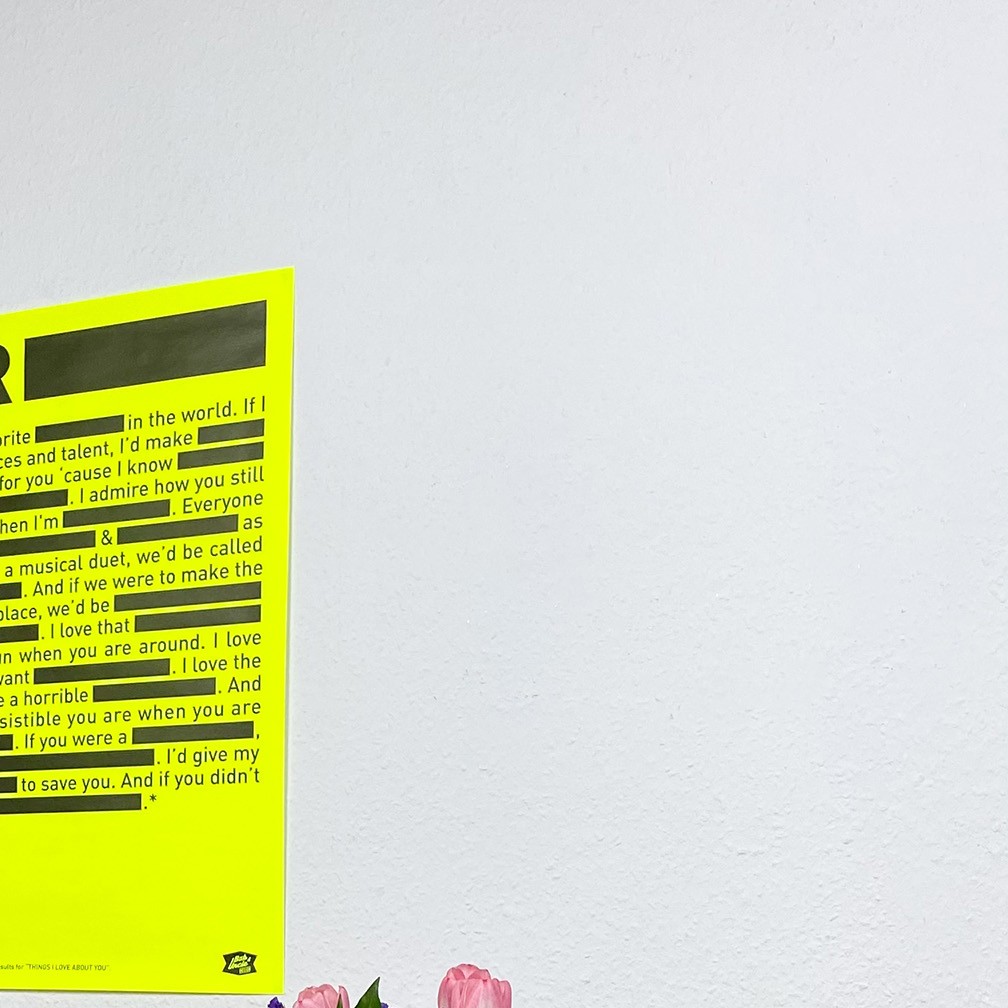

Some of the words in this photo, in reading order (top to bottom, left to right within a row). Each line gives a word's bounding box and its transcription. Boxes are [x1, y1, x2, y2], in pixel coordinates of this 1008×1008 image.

[128, 414, 143, 431] in
[149, 410, 176, 428] the
[181, 400, 237, 423] world.
[244, 396, 256, 415] If
[261, 395, 265, 412] I
[26, 446, 56, 466] and
[61, 441, 114, 461] talent,
[120, 435, 140, 454] I'd
[146, 431, 193, 450] make
[25, 473, 54, 492] you
[59, 466, 112, 483] 'cause
[118, 460, 121, 477] I
[127, 458, 173, 475] know
[80, 487, 84, 504] I
[89, 482, 149, 503] admire
[154, 478, 190, 495] how
[194, 474, 225, 494] you
[230, 465, 264, 486] still
[34, 514, 59, 531] I'm
[183, 493, 264, 514] Everyone
[101, 529, 113, 546] &
[243, 516, 263, 530] as
[4, 565, 13, 578] a
[19, 554, 83, 576] musical
[89, 551, 130, 570] duet,
[136, 544, 176, 565] we'd
[183, 543, 203, 560] be
[210, 535, 262, 557] called
[32, 578, 64, 597] And
[69, 576, 80, 593] if
[84, 578, 107, 592] we
[112, 574, 154, 589] were
[159, 570, 176, 585] to
[181, 563, 229, 583] make
[235, 560, 263, 578] the
[47, 598, 85, 617] we'd
[90, 597, 110, 614] be
[51, 623, 54, 639] I
[60, 622, 92, 638] love
[97, 618, 130, 635] that
[19, 646, 62, 663] when
[69, 646, 97, 664] you
[104, 643, 132, 657] are
[139, 633, 205, 654] around.
[214, 632, 218, 649] I
[227, 631, 262, 648] love
[183, 657, 186, 674] I
[193, 656, 228, 673] love
[233, 652, 261, 670] the
[9, 695, 18, 707] a
[24, 687, 89, 706] horrible
[227, 674, 261, 693] And
[67, 712, 97, 729] you
[103, 710, 132, 724] are
[137, 704, 186, 721] when
[192, 704, 224, 723] you
[231, 702, 261, 716] are
[25, 733, 35, 749] If
[39, 735, 67, 753] you
[72, 733, 113, 747] were
[118, 732, 127, 745] a
[167, 747, 187, 764] I'd
[192, 746, 228, 768] give
[234, 748, 260, 765] my
[21, 778, 36, 792] to
[41, 778, 77, 792] save
[81, 777, 115, 794] you.
[120, 771, 153, 789] And
[159, 770, 170, 787] if
[174, 773, 204, 791] you
[210, 767, 260, 785] didn't
[55, 963, 70, 971] LOVE
